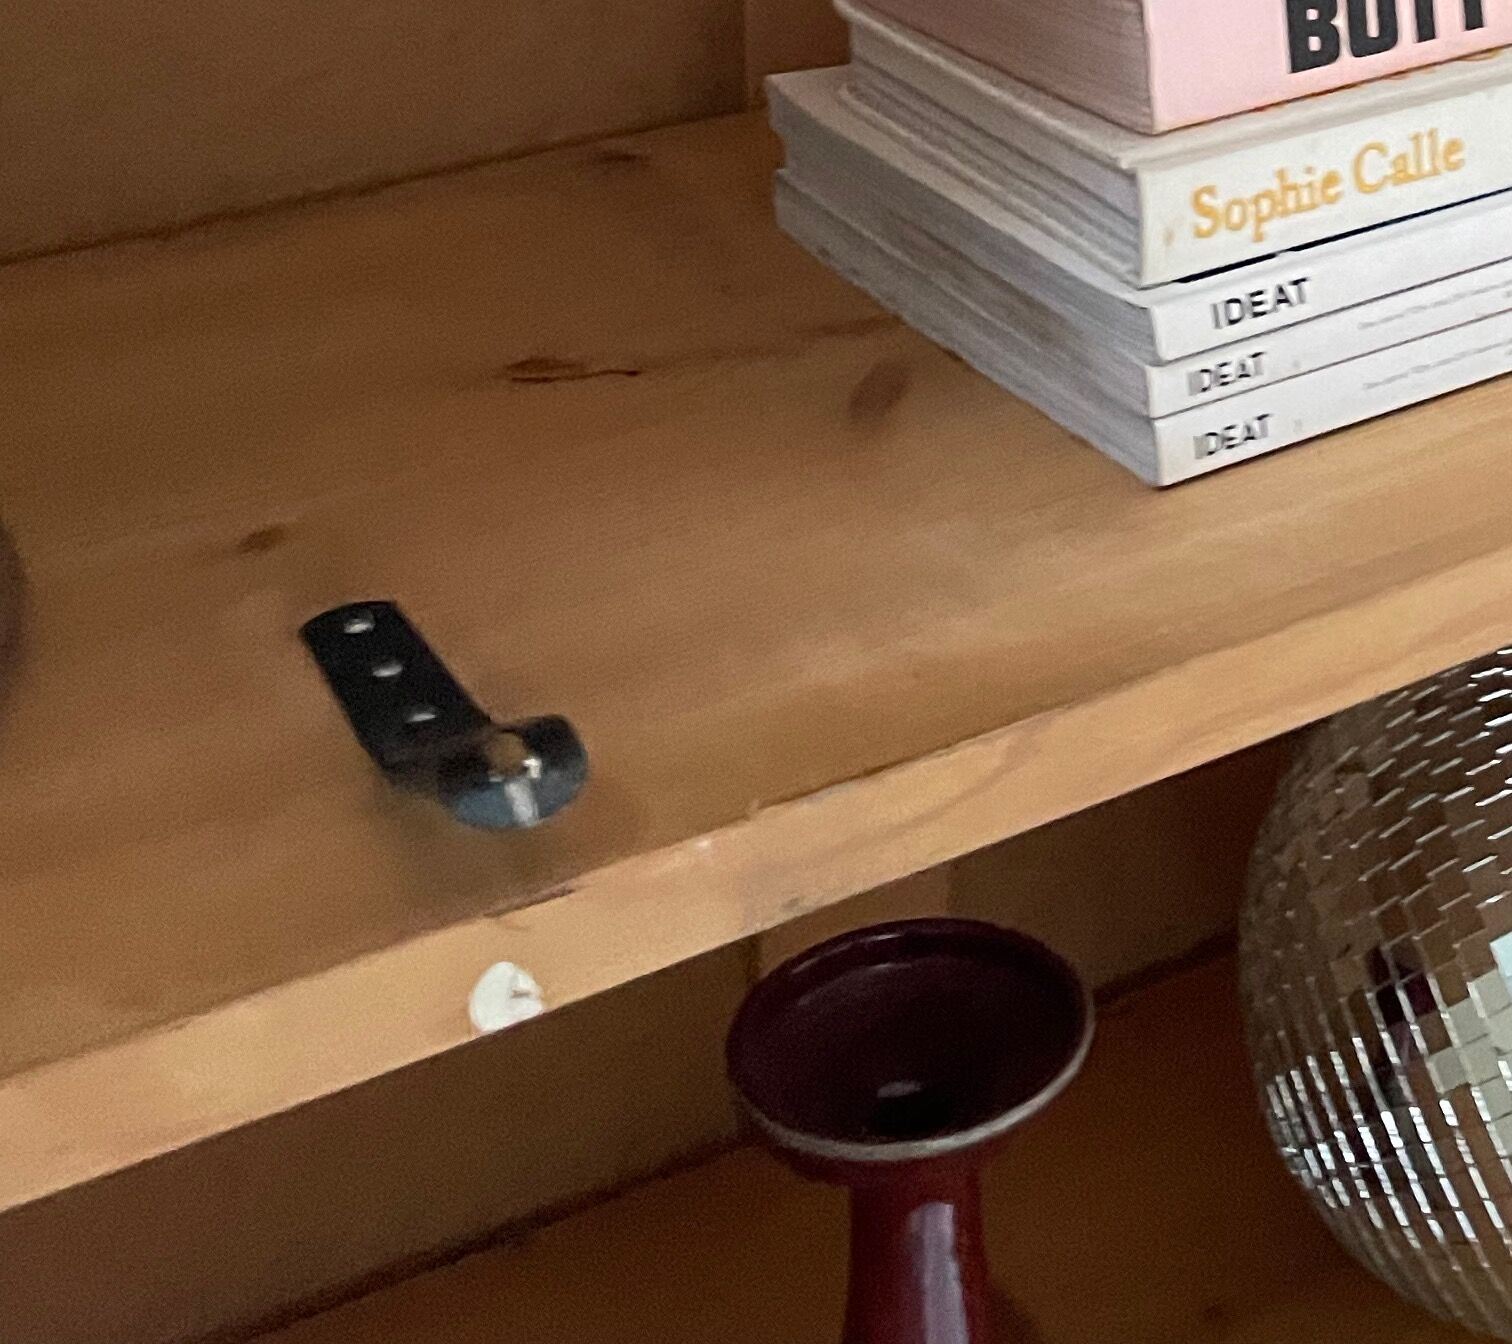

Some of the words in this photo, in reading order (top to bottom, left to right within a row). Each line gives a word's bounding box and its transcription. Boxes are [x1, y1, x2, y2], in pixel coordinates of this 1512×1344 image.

[1191, 166, 1342, 243] Sophie
[1353, 128, 1467, 194] Calle
[1210, 277, 1310, 330] IDEAT
[1187, 351, 1267, 396] IDEAT
[1193, 413, 1272, 460] IDEAT
